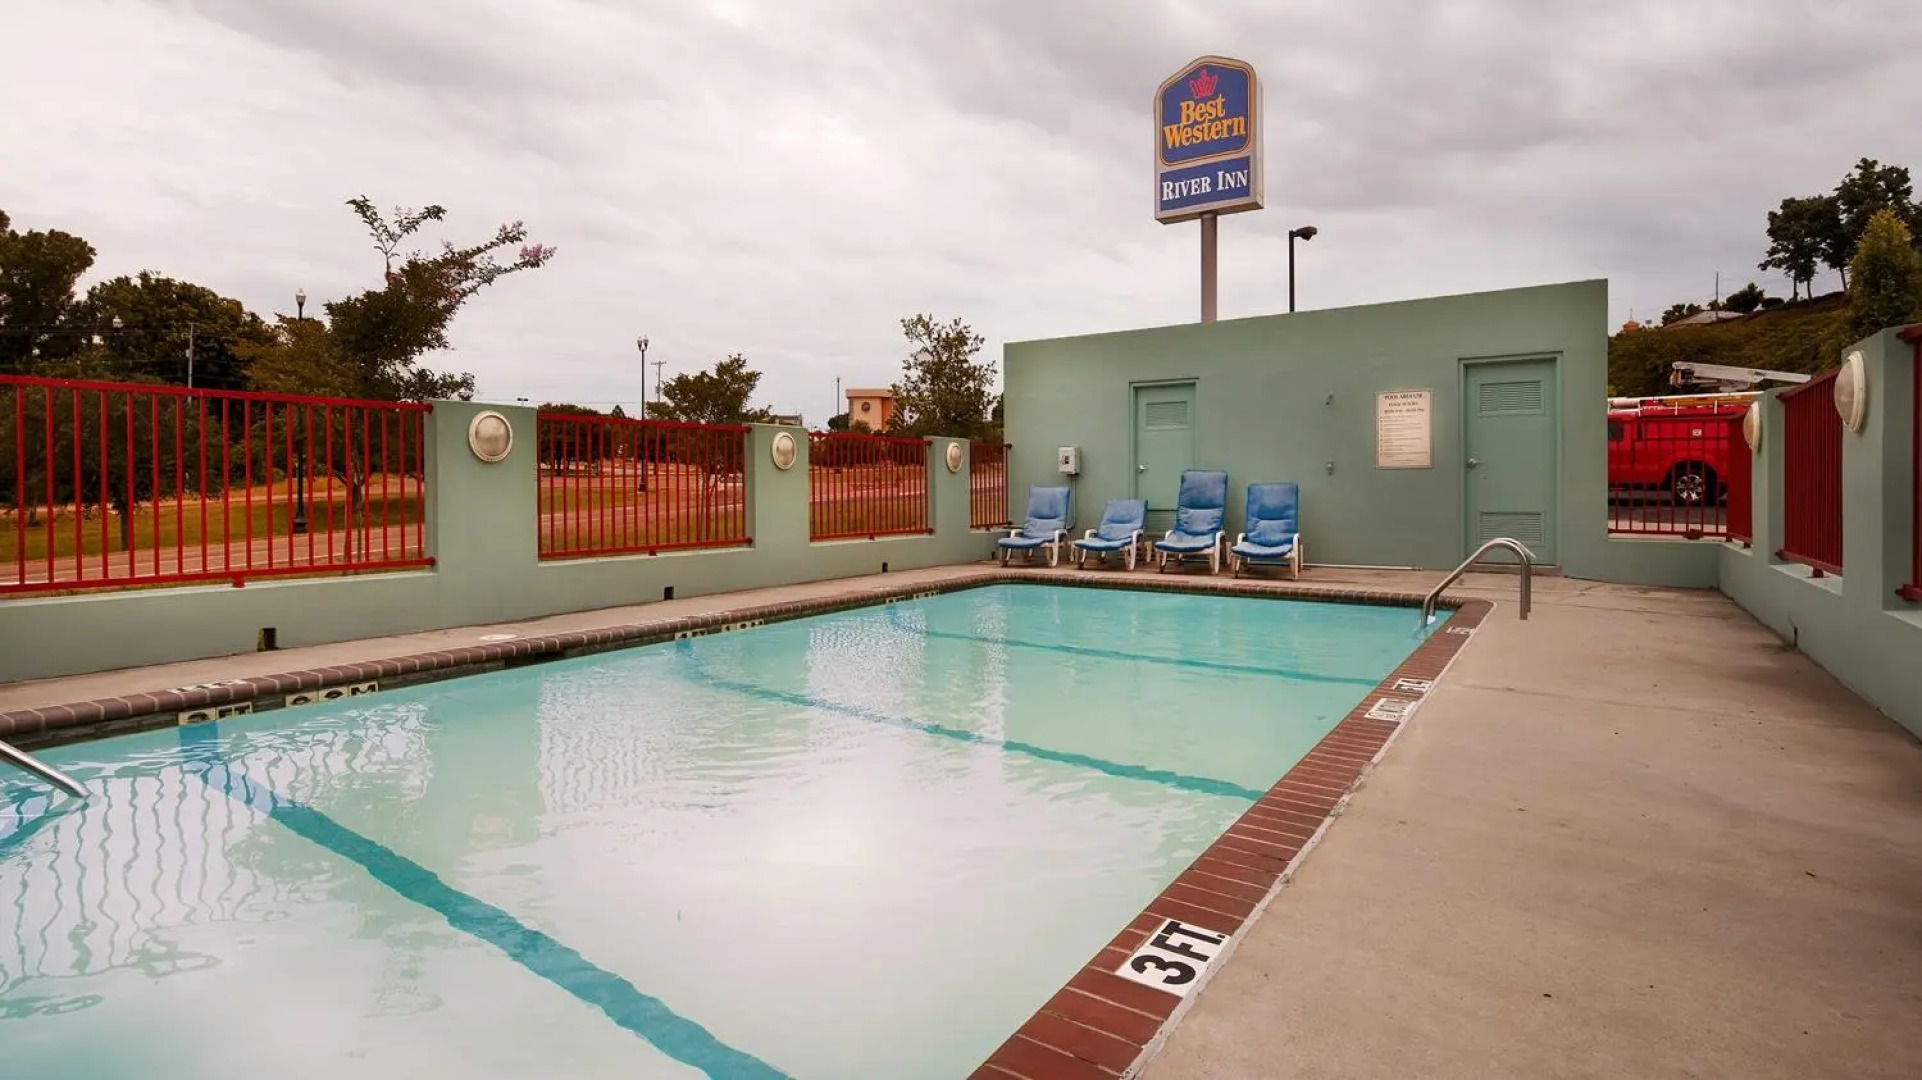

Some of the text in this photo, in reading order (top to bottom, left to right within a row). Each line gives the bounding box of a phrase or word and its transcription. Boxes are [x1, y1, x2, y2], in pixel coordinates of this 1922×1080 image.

[1179, 94, 1226, 126] Best
[1163, 115, 1245, 149] Western
[1162, 170, 1248, 201] RIVER INN
